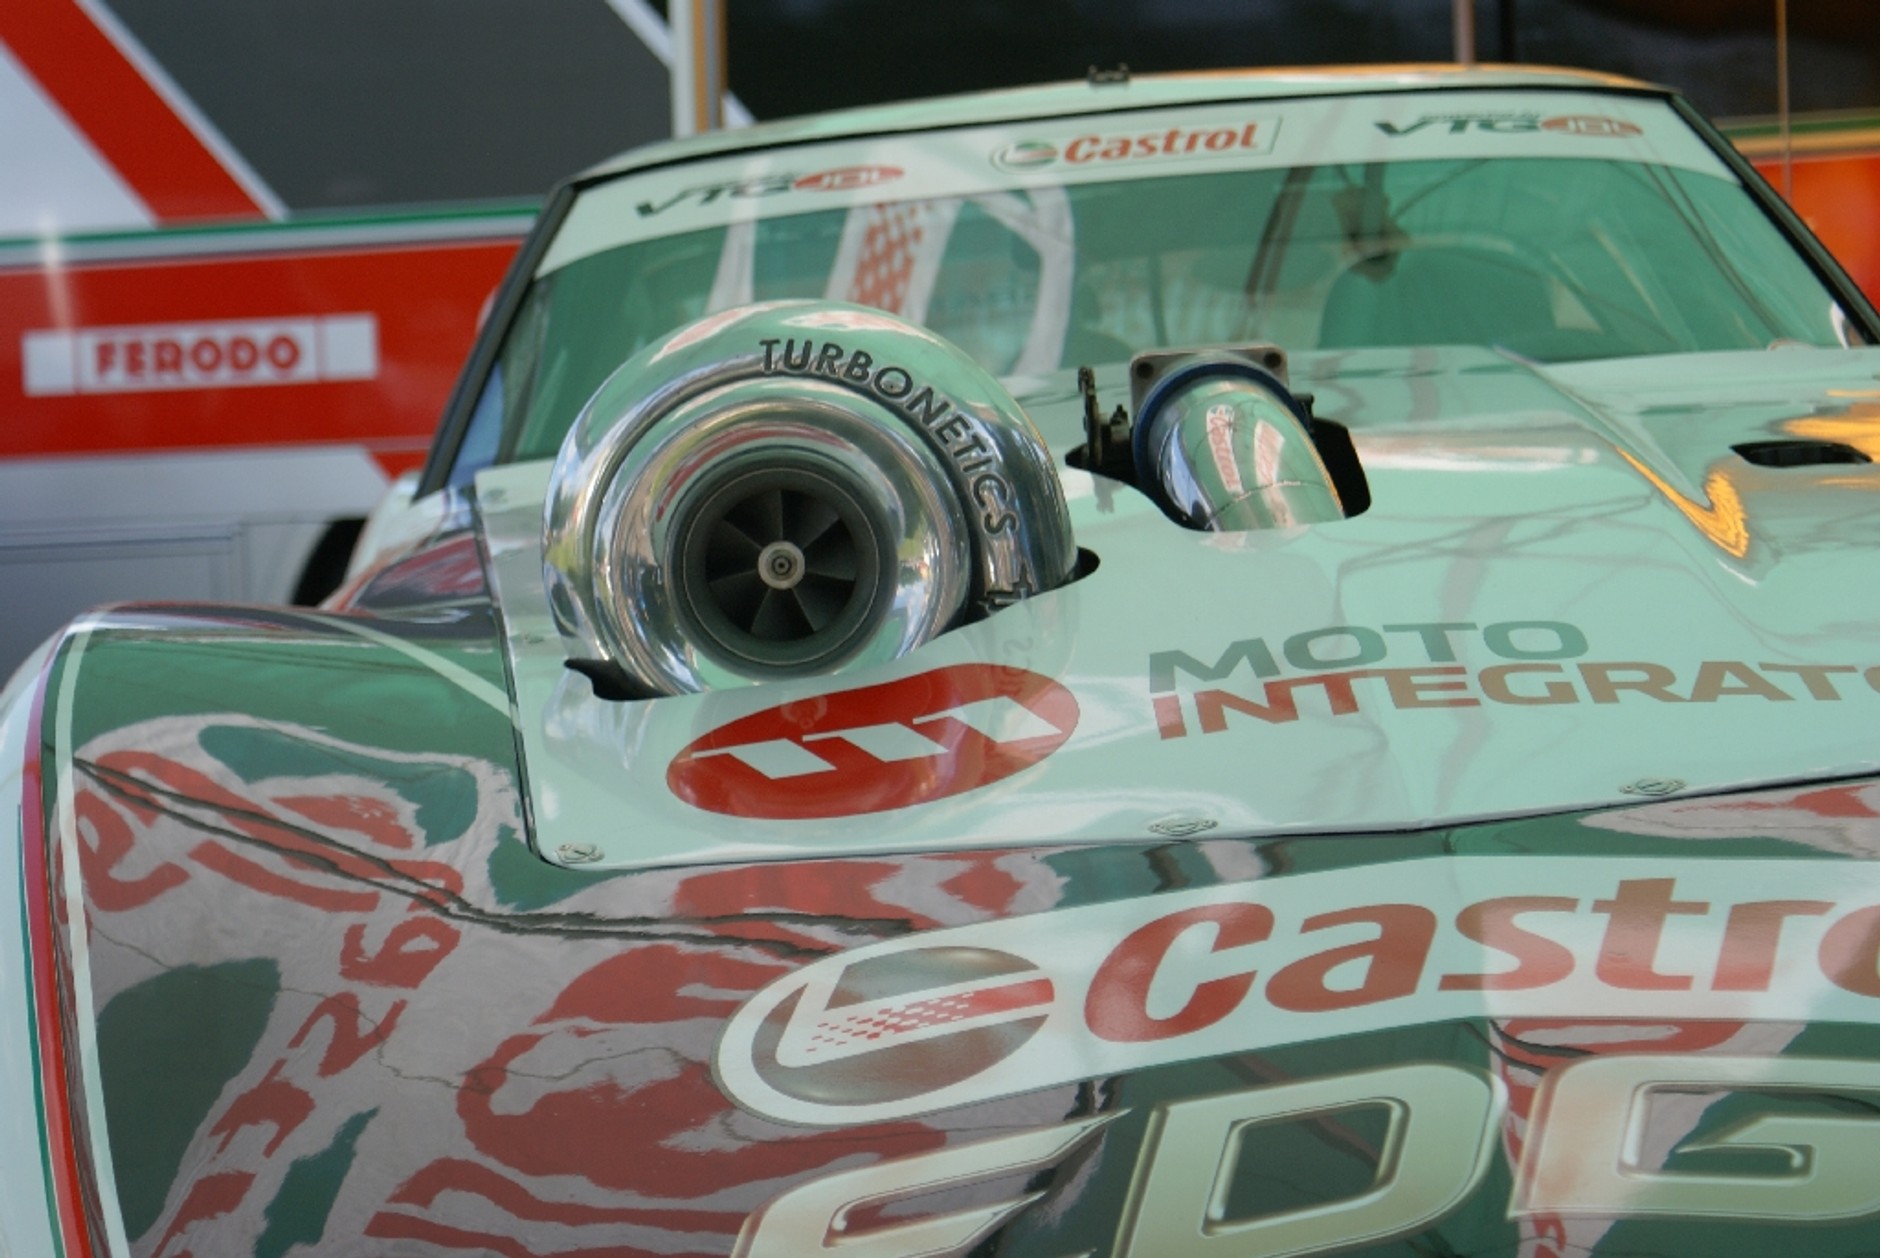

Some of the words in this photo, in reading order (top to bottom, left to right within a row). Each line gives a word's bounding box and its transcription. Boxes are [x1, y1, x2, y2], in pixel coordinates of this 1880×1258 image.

[1064, 122, 1257, 164] Castrol
[96, 334, 300, 377] FERODO
[758, 338, 1018, 536] TURBONETICS
[1149, 620, 1588, 693] MOTO
[1153, 661, 1880, 741] INTEGRAT
